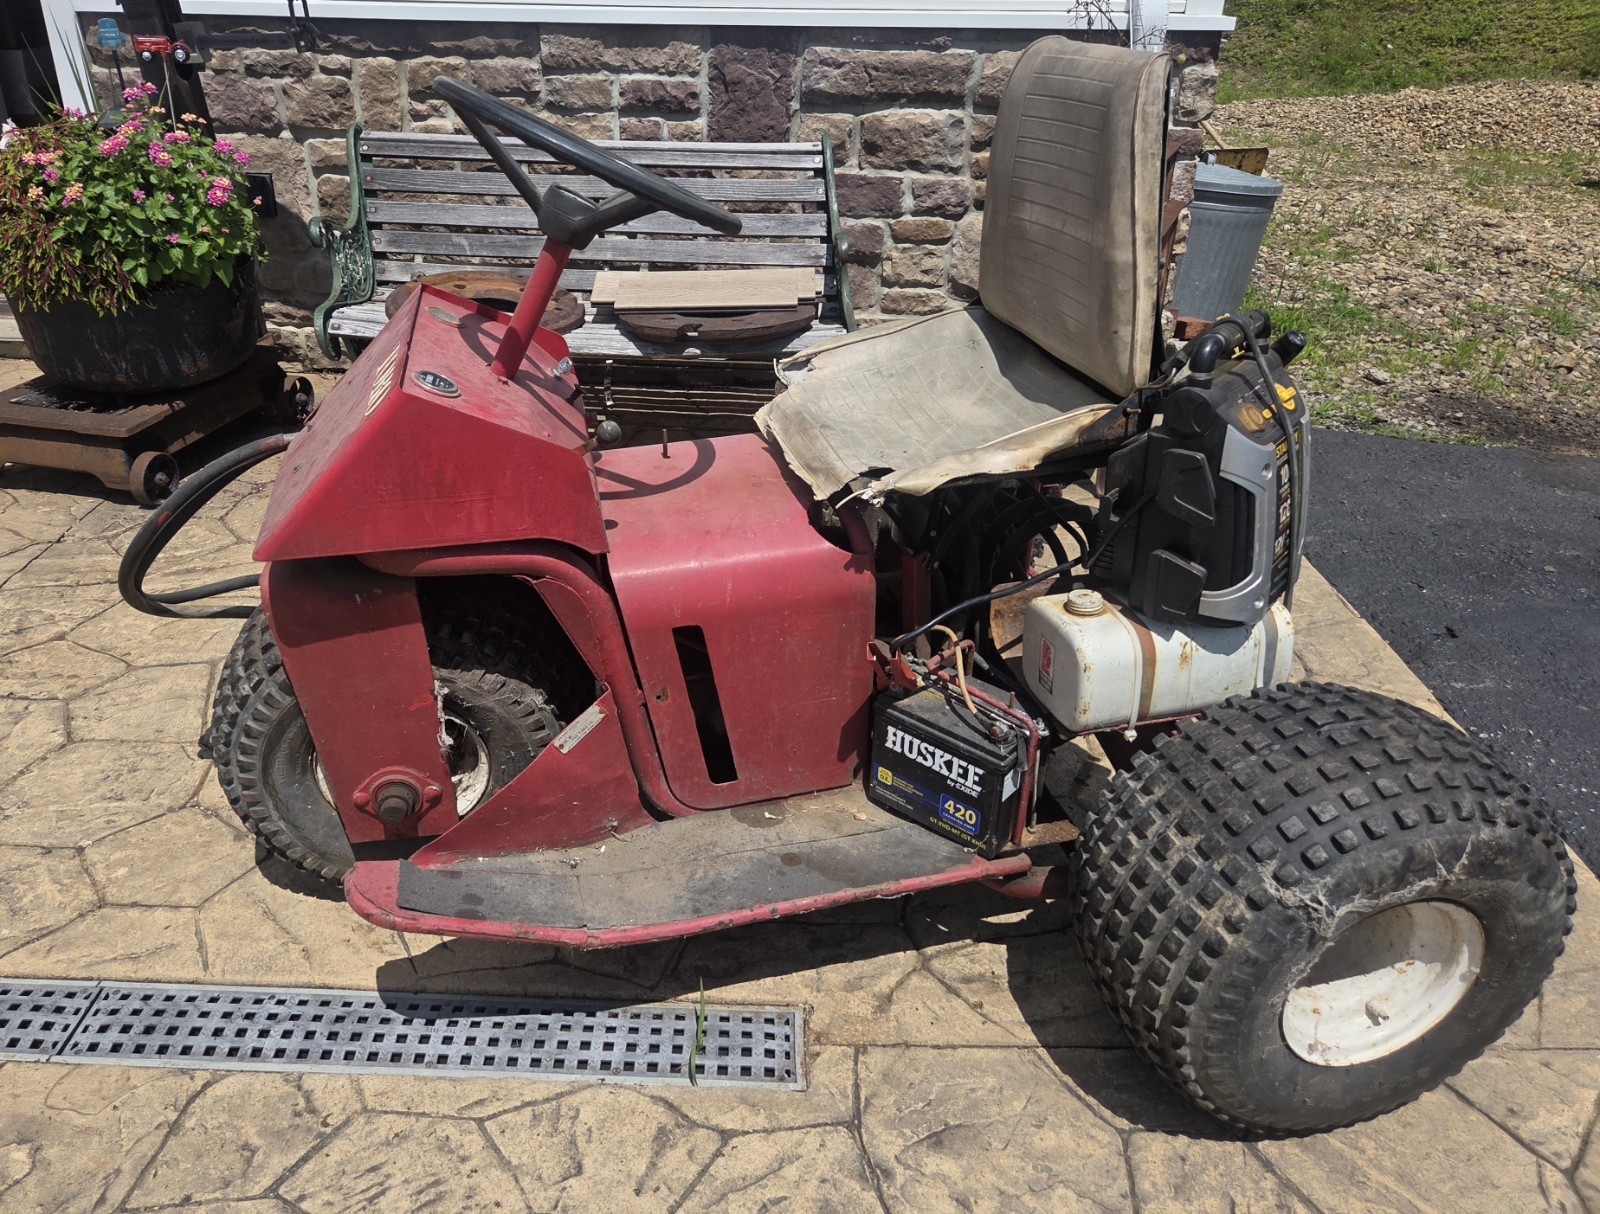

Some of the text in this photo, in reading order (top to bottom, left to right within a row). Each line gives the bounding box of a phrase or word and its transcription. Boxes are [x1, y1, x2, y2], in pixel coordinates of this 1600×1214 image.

[884, 725, 985, 793] HUSKEE
[946, 779, 981, 799] by EXIDE
[944, 800, 977, 825] 420
